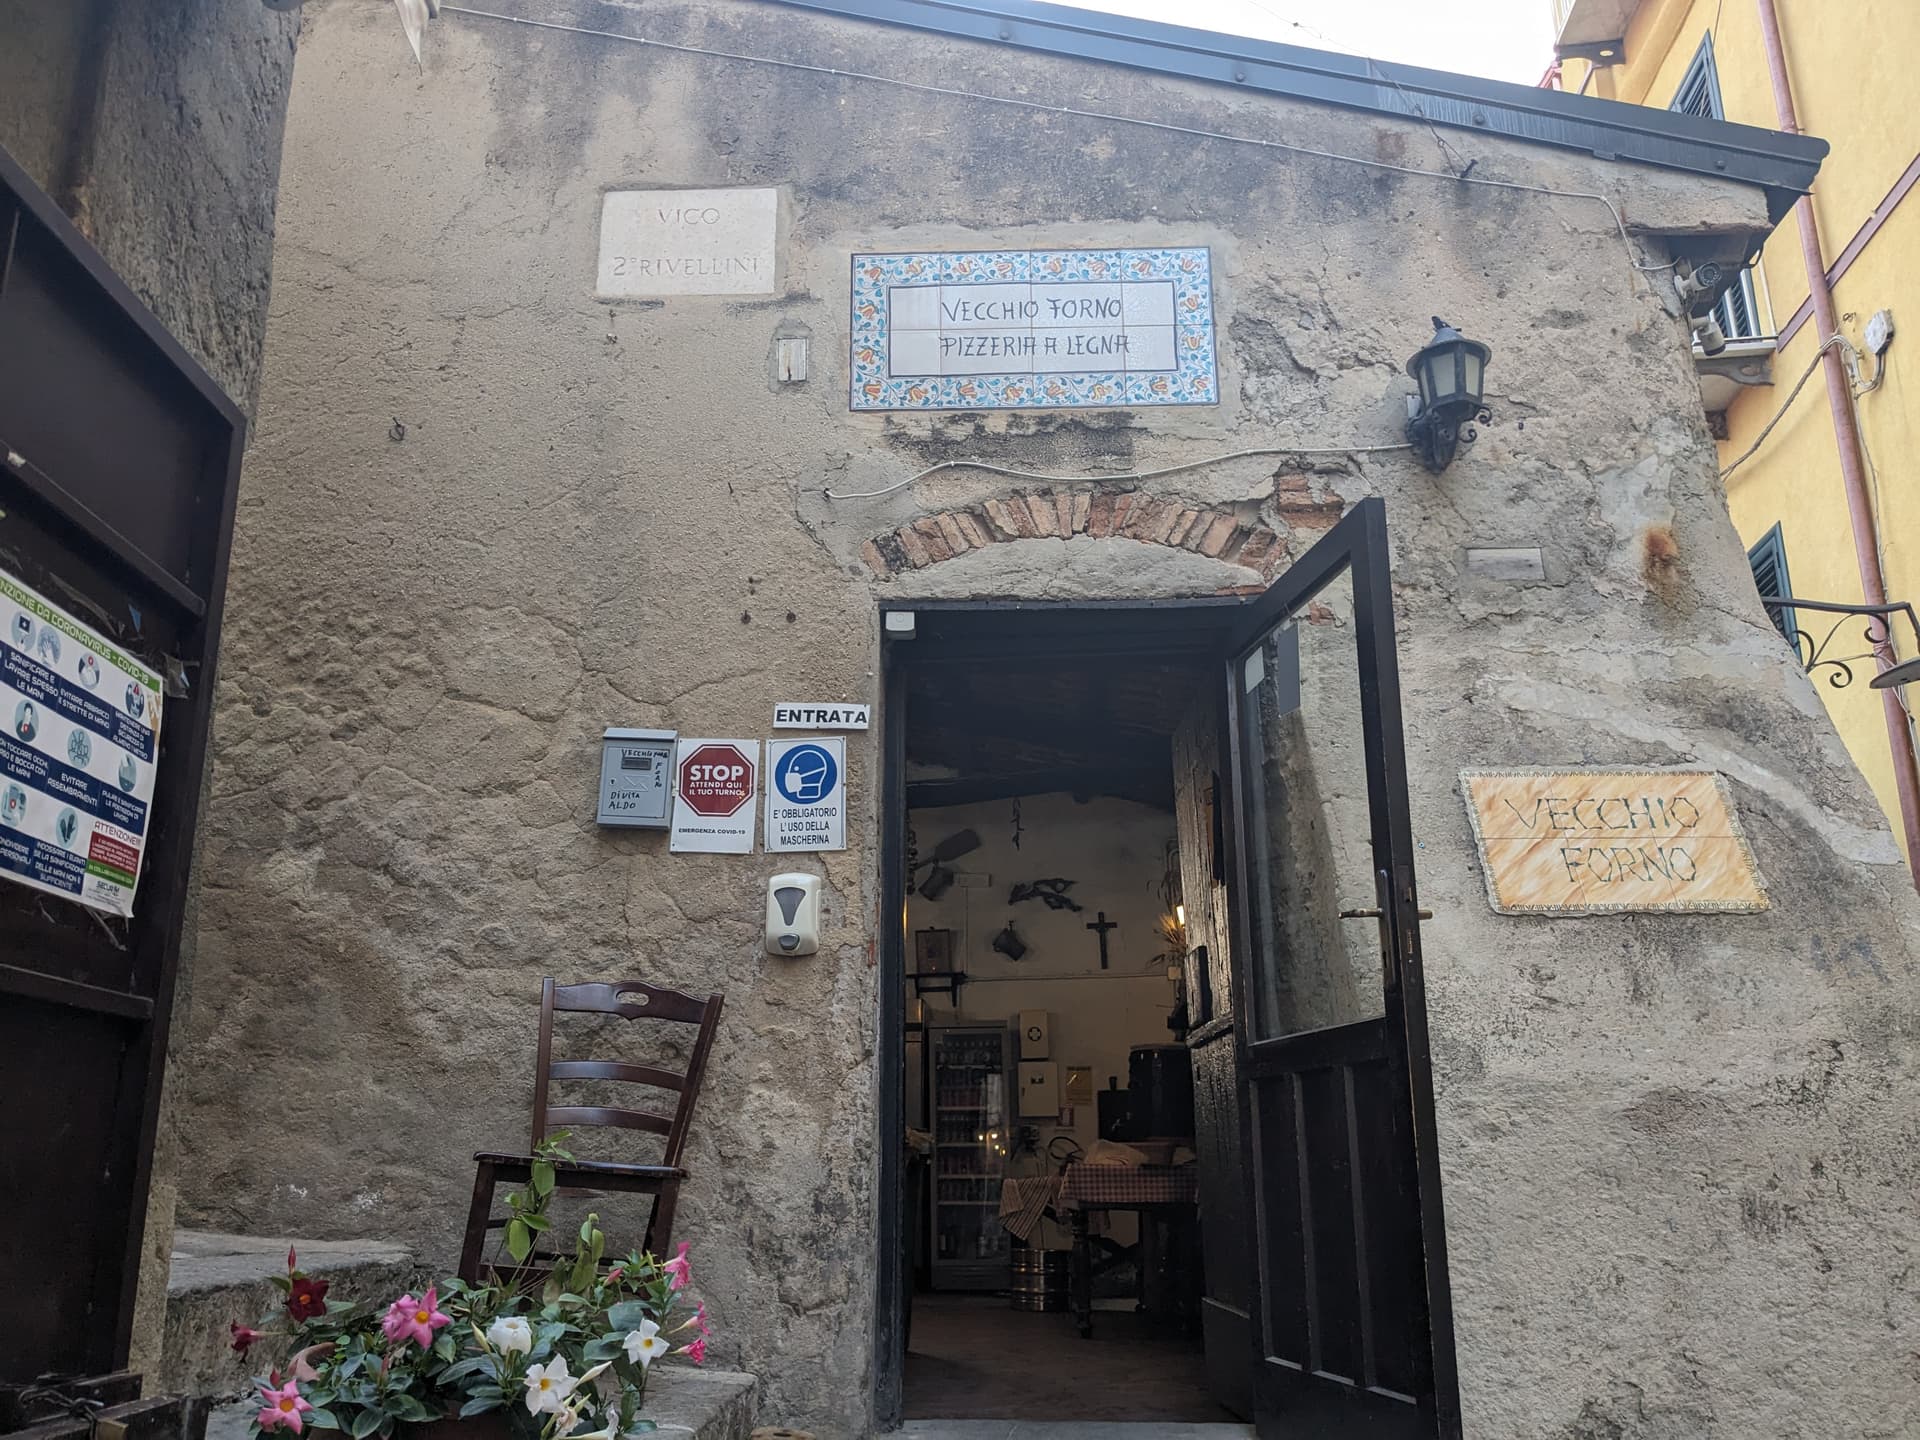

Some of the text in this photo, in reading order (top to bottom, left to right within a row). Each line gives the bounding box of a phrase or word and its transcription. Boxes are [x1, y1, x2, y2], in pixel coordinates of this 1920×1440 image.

[658, 207, 721, 225] VICO
[942, 298, 1122, 322] VECCHIO FORNO
[939, 334, 1131, 357] PIZZERIA A LEGNA
[36, 603, 50, 620] DA
[51, 613, 111, 660] CORONAVIRUS
[118, 656, 148, 684] COVID-19
[32, 676, 58, 696] SPESSO
[776, 710, 868, 723] ENTRATA
[8, 763, 15, 772] LE
[15, 757, 34, 770] BOCCA
[690, 765, 744, 781] STOP
[62, 773, 88, 791] EVITARE
[608, 802, 636, 810] ALDO
[774, 808, 837, 819] E' OBBLIGATORIO
[1504, 797, 1699, 830] VECCHIO
[780, 822, 830, 832] L' USO DELLA
[780, 835, 830, 846] MASCHERINA
[1560, 847, 1697, 883] FORNO
